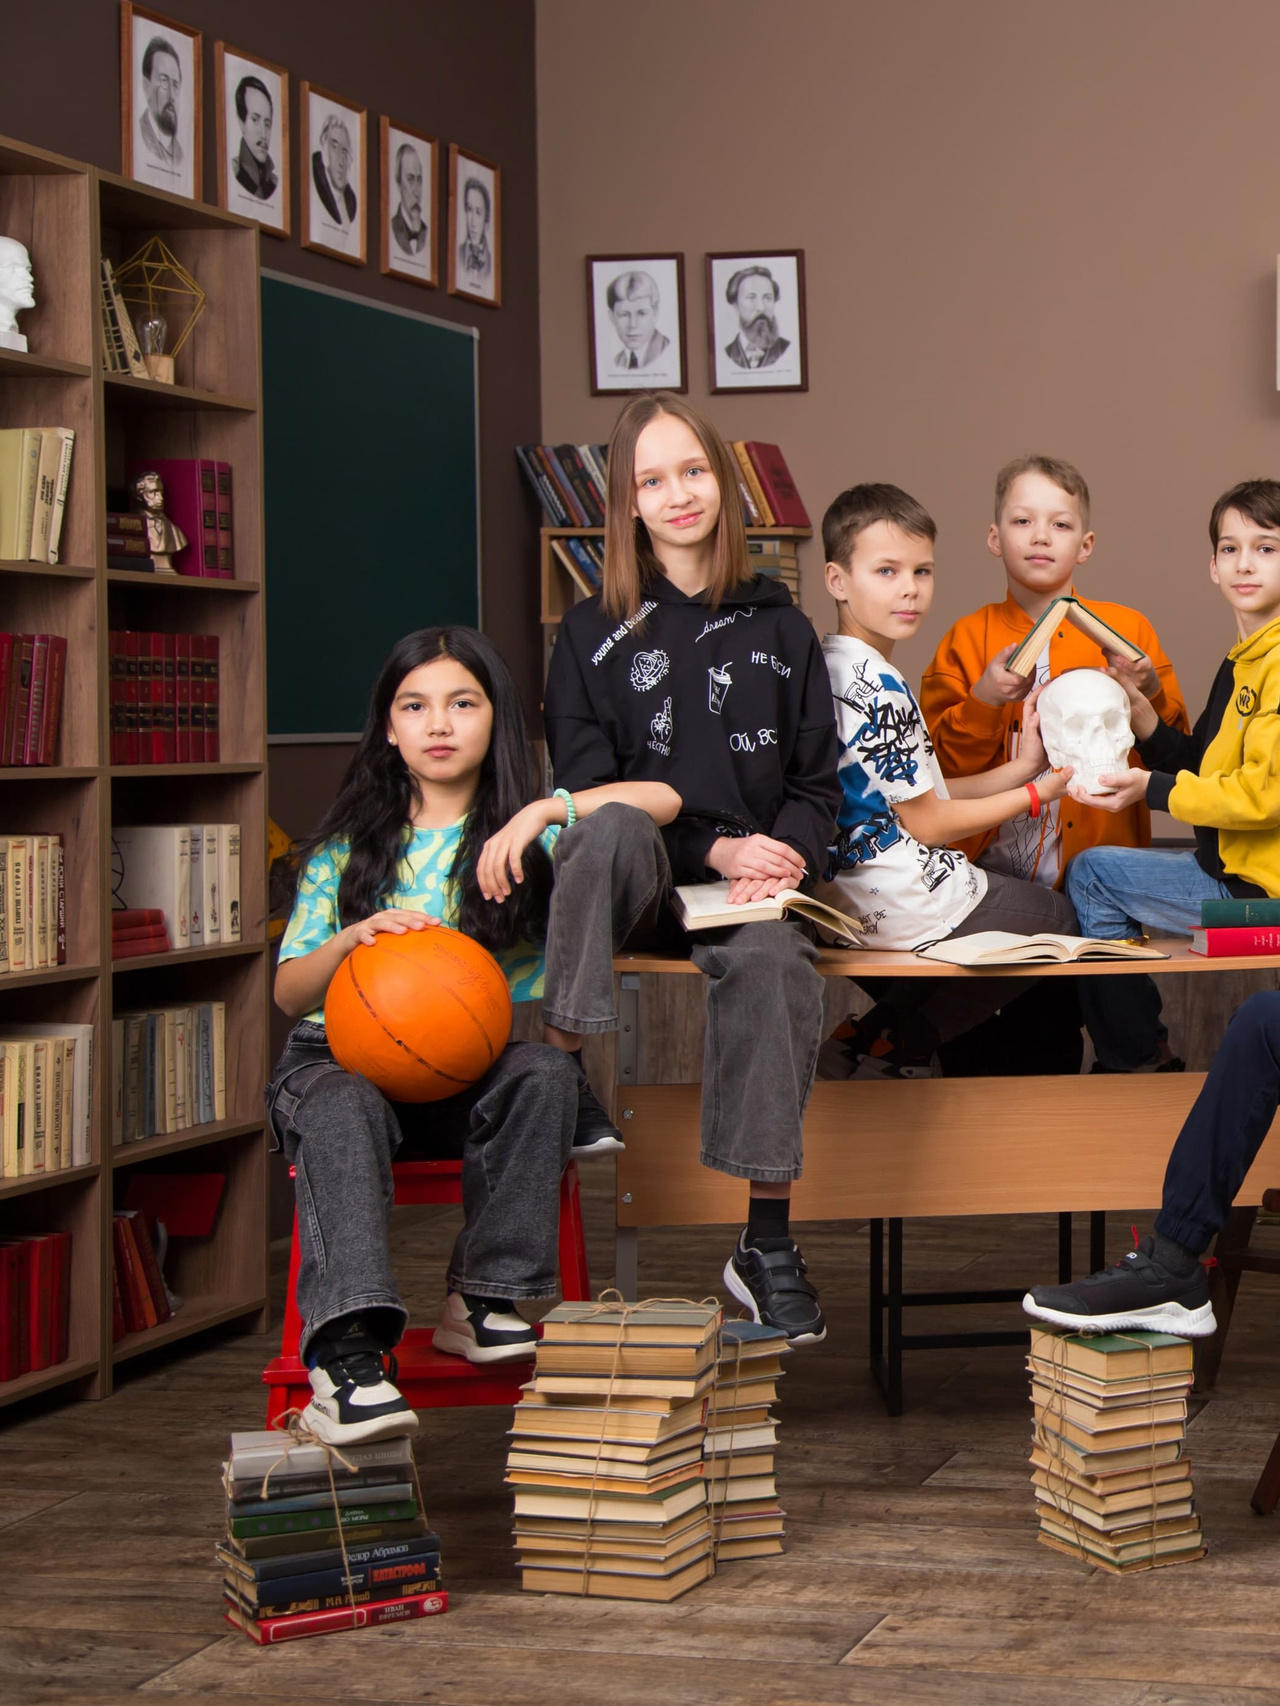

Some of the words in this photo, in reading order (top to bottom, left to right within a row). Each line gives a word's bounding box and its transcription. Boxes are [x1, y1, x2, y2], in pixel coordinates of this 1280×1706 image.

[591, 636, 615, 666] young
[612, 624, 628, 641] and
[624, 601, 659, 629] beautifu
[751, 650, 768, 665] НЕ
[730, 732, 756, 752] ОЙ
[757, 728, 778, 746] ВС
[873, 909, 887, 921] BE
[371, 1544, 409, 1560] Абрамов
[373, 1562, 427, 1582] КАТАСТРОФА
[384, 1604, 404, 1613] ИВАН
